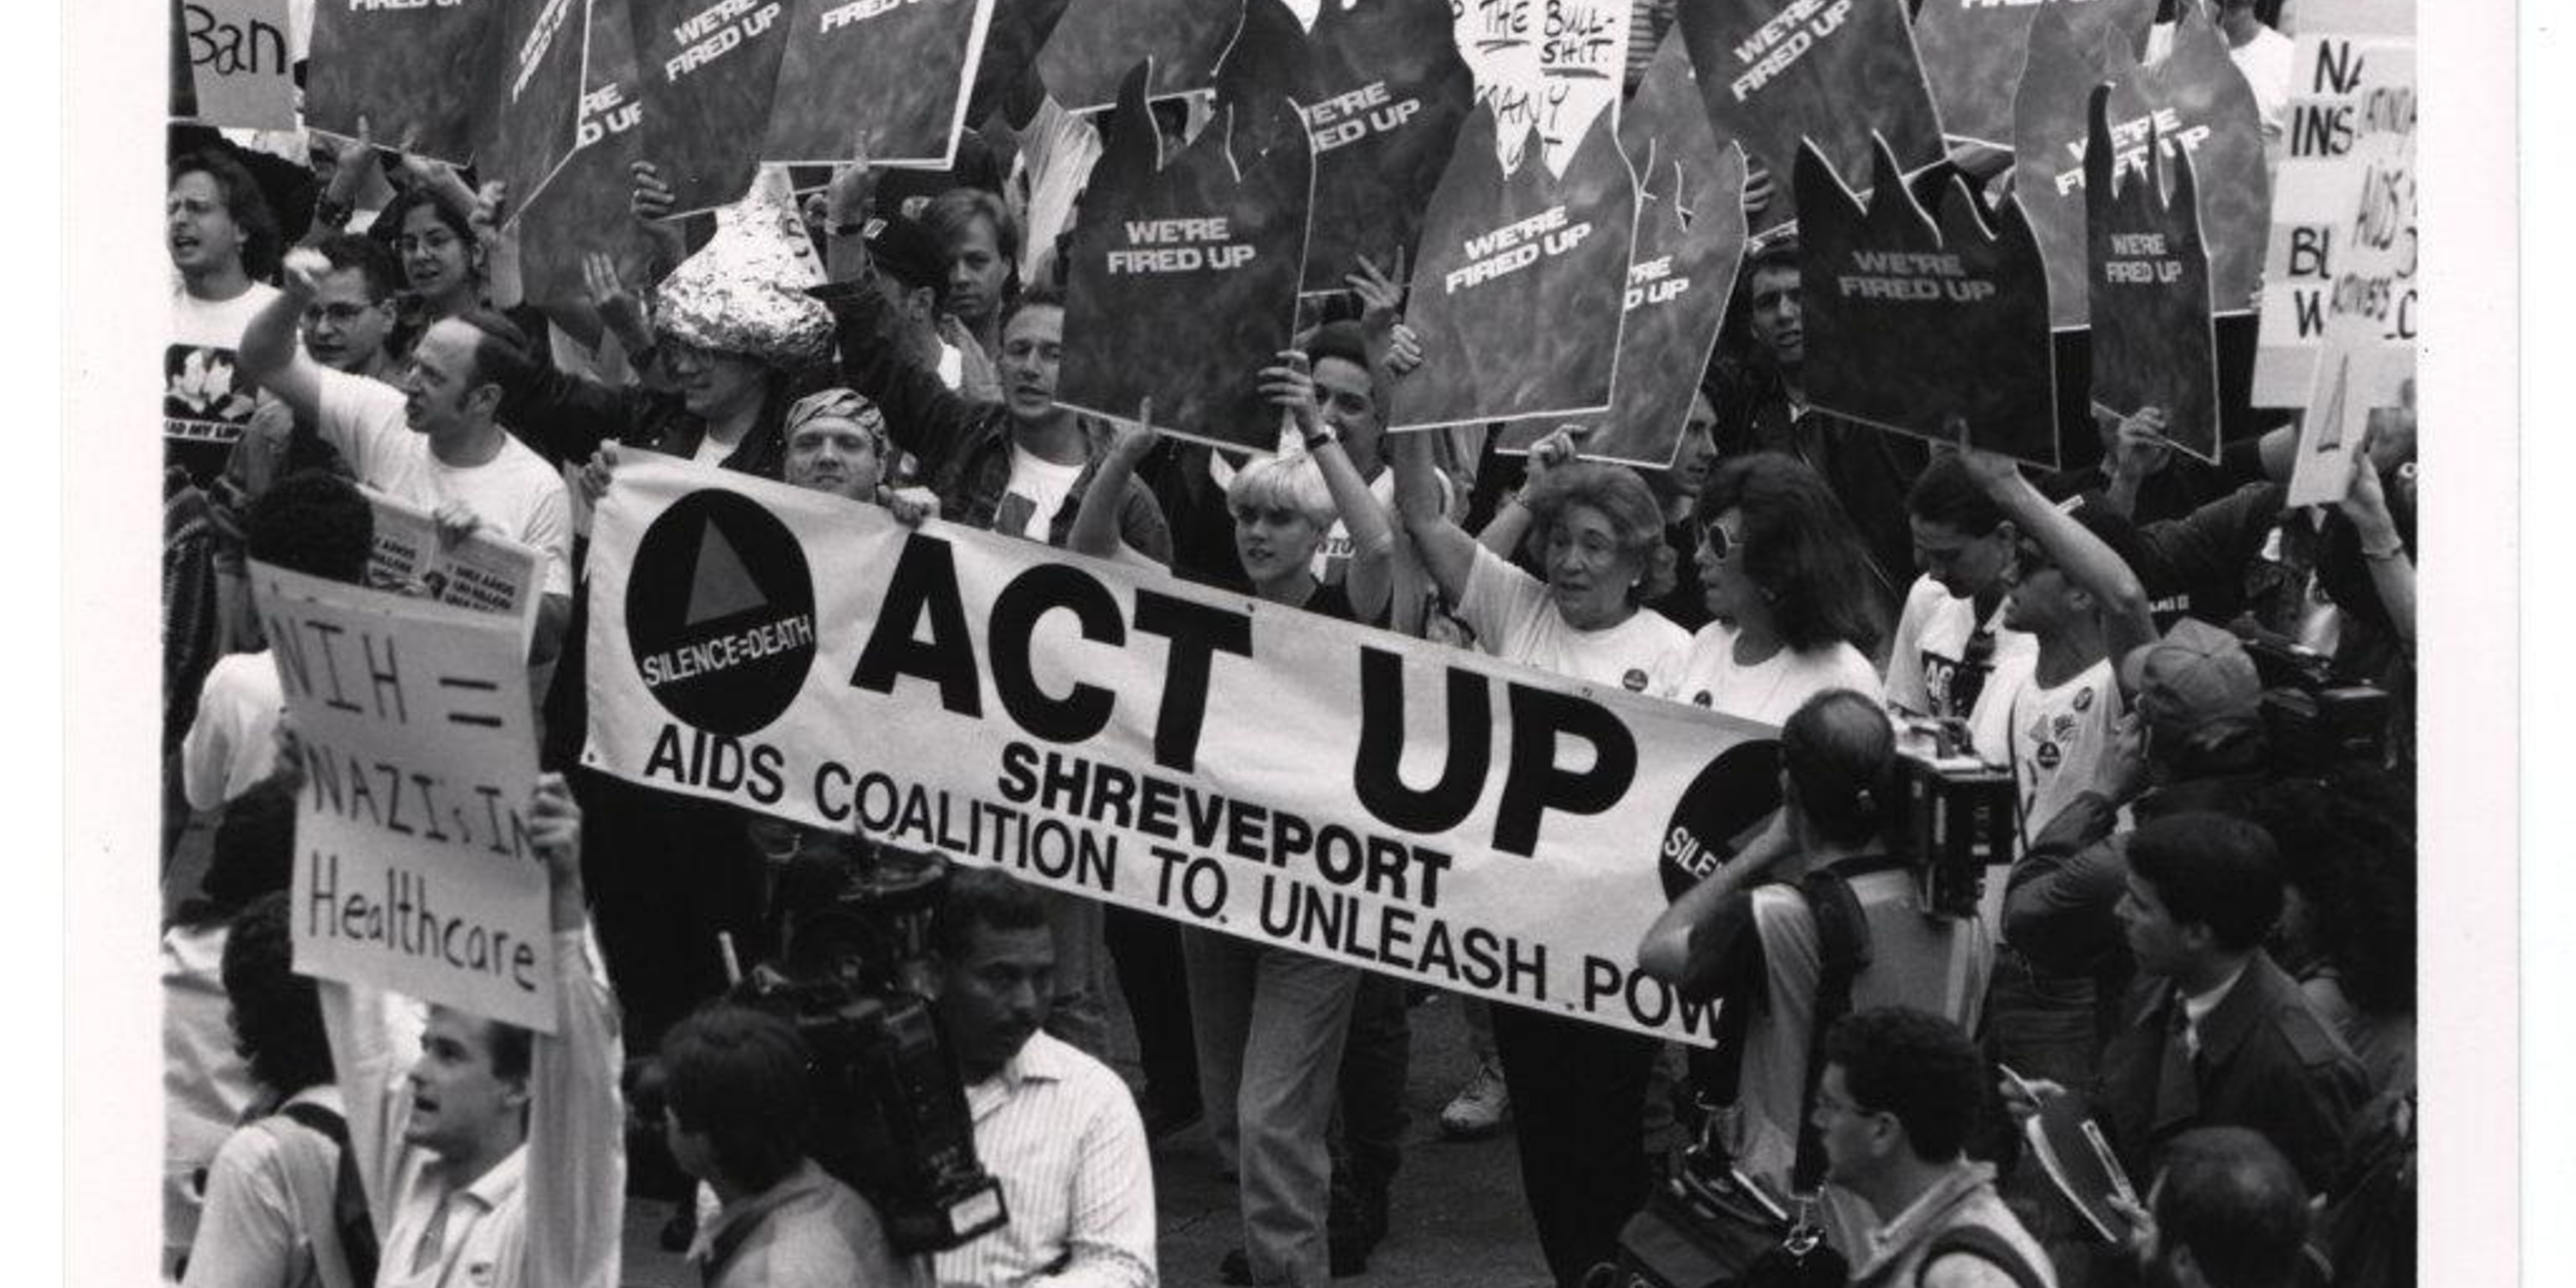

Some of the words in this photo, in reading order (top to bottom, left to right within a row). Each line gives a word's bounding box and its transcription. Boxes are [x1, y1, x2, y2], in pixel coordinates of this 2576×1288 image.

[185, 4, 286, 76] Ban
[665, 25, 741, 82] FIRED
[742, 2, 781, 37] UP
[1479, 0, 1529, 39] THE
[1731, 30, 1812, 102] FIRED
[1811, 0, 1852, 38] UP
[1370, 98, 1420, 131] UP
[2291, 106, 2353, 157] INS
[1107, 247, 1202, 274] FIRED
[1207, 244, 1255, 270] UP
[1125, 217, 1230, 245] WE'RE
[1446, 243, 1540, 295] FIRED
[1544, 222, 1591, 256] UP
[1464, 205, 1568, 260] WE'RE
[1648, 278, 1689, 303] UP
[1838, 276, 1941, 300] FIRED
[1945, 279, 1996, 301] UP
[1851, 250, 1965, 276] WE'RE
[2105, 260, 2154, 283] FIRED
[2155, 261, 2183, 283] UP
[268, 615, 407, 725] NIH
[644, 614, 813, 687] SILENCE=DEATH
[849, 532, 1254, 774] ACT
[1352, 644, 1637, 858] UP
[998, 741, 1452, 908] SHREVEPORT
[643, 722, 785, 805] AIDS
[814, 761, 1118, 892] COALITION
[1259, 874, 1547, 1003] UNLEASH
[310, 850, 538, 993] Healthcare
